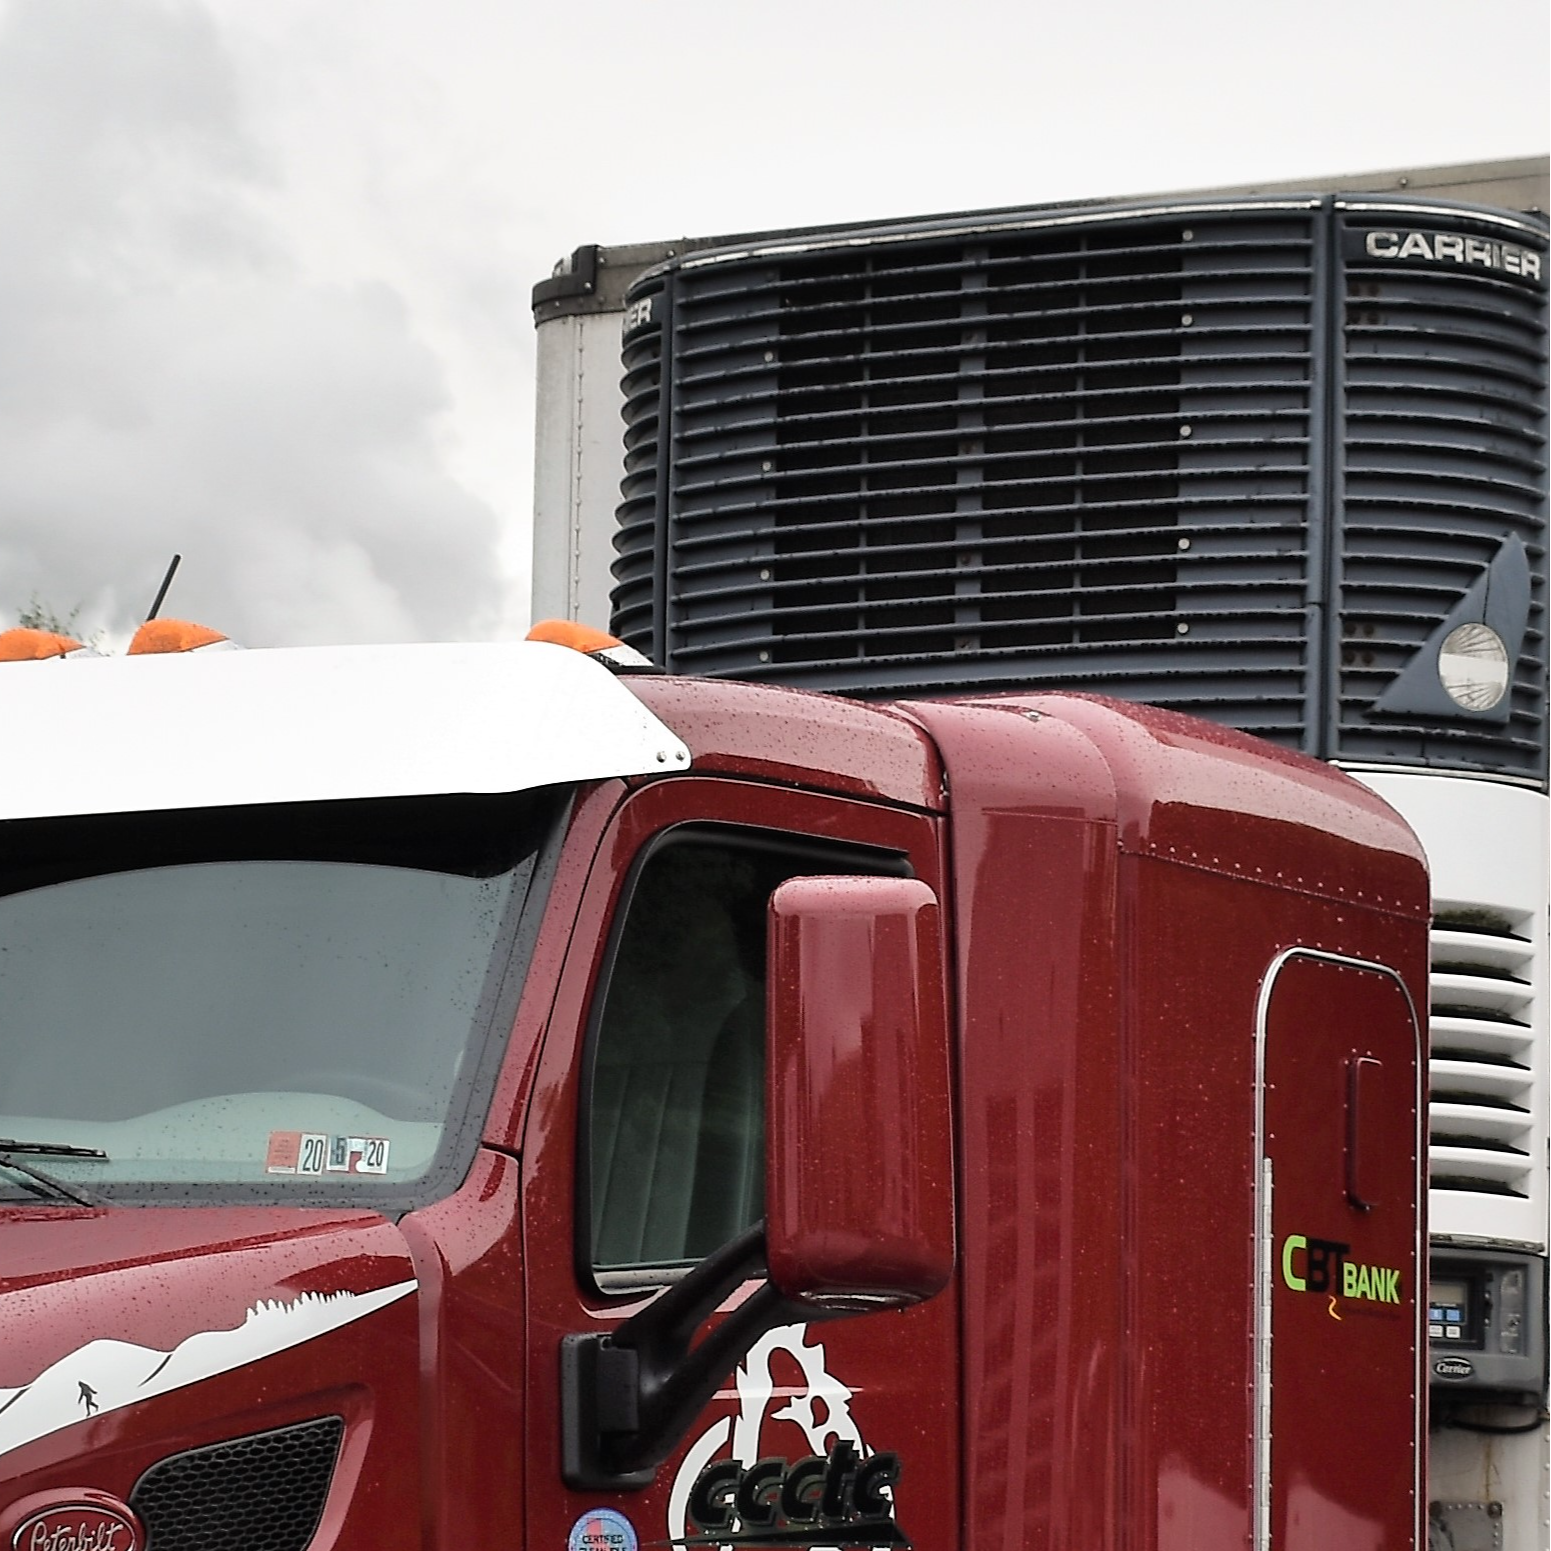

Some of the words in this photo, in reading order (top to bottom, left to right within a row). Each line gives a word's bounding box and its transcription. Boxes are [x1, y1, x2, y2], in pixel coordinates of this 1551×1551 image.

[1366, 231, 1541, 282] CARRIER
[302, 1139, 324, 1172] 20
[367, 1141, 385, 1167] 20
[1282, 1234, 1351, 1296] CBT
[1343, 1261, 1400, 1304] BANK
[1435, 1362, 1472, 1375] Carrier
[582, 1535, 624, 1544] CERTIFIED
